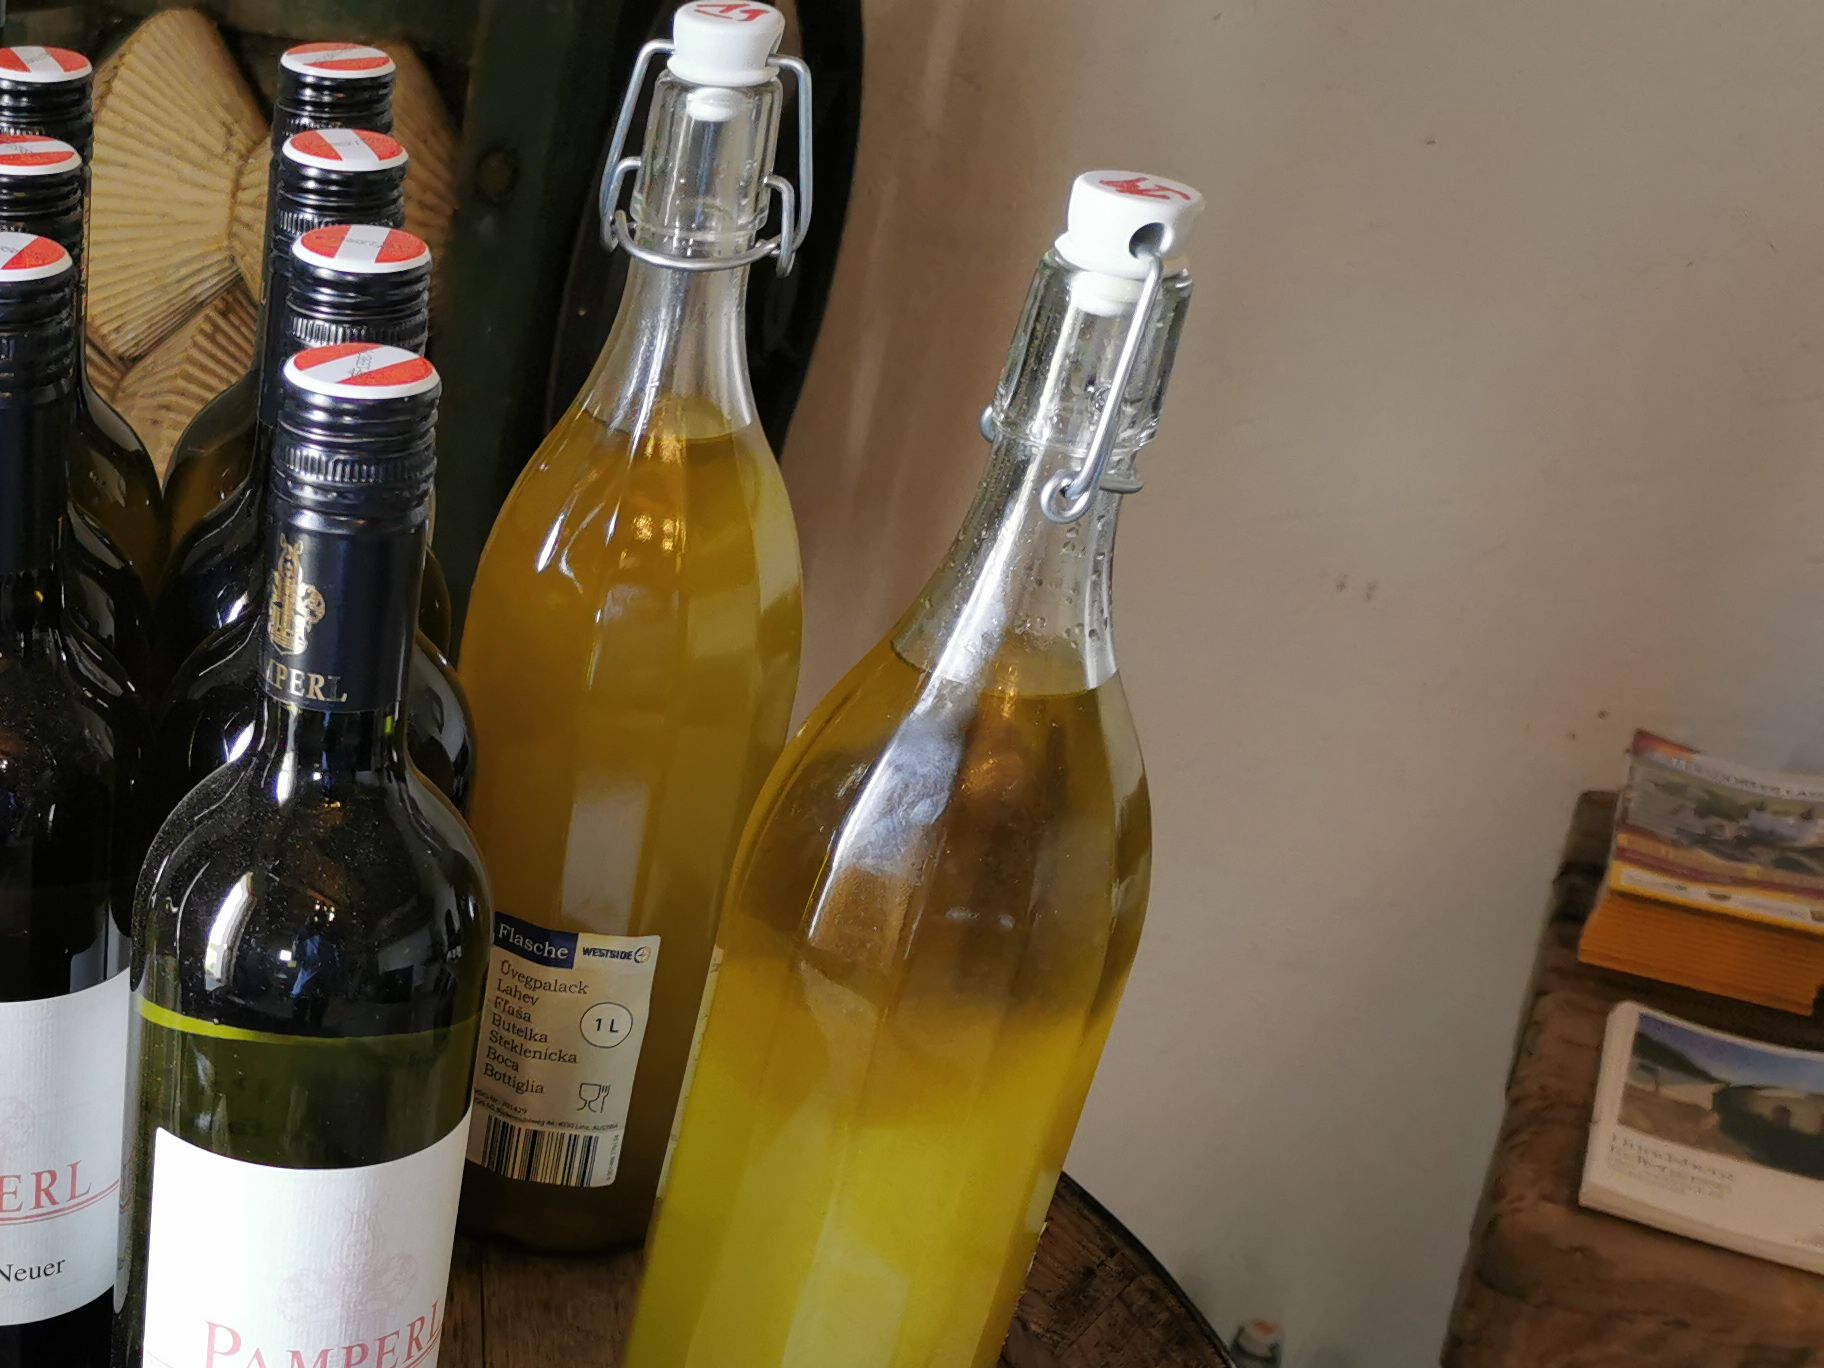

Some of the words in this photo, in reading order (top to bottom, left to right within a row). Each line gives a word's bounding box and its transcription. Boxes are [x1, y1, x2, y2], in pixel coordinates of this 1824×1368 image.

[497, 922, 569, 960] Flasche
[582, 946, 633, 961] WESTSIDE
[490, 1012, 549, 1044] Butelka
[595, 1018, 603, 1032] 1
[609, 1018, 619, 1033] L
[485, 1046, 520, 1073] Boca
[482, 1062, 545, 1095] Bottiglia
